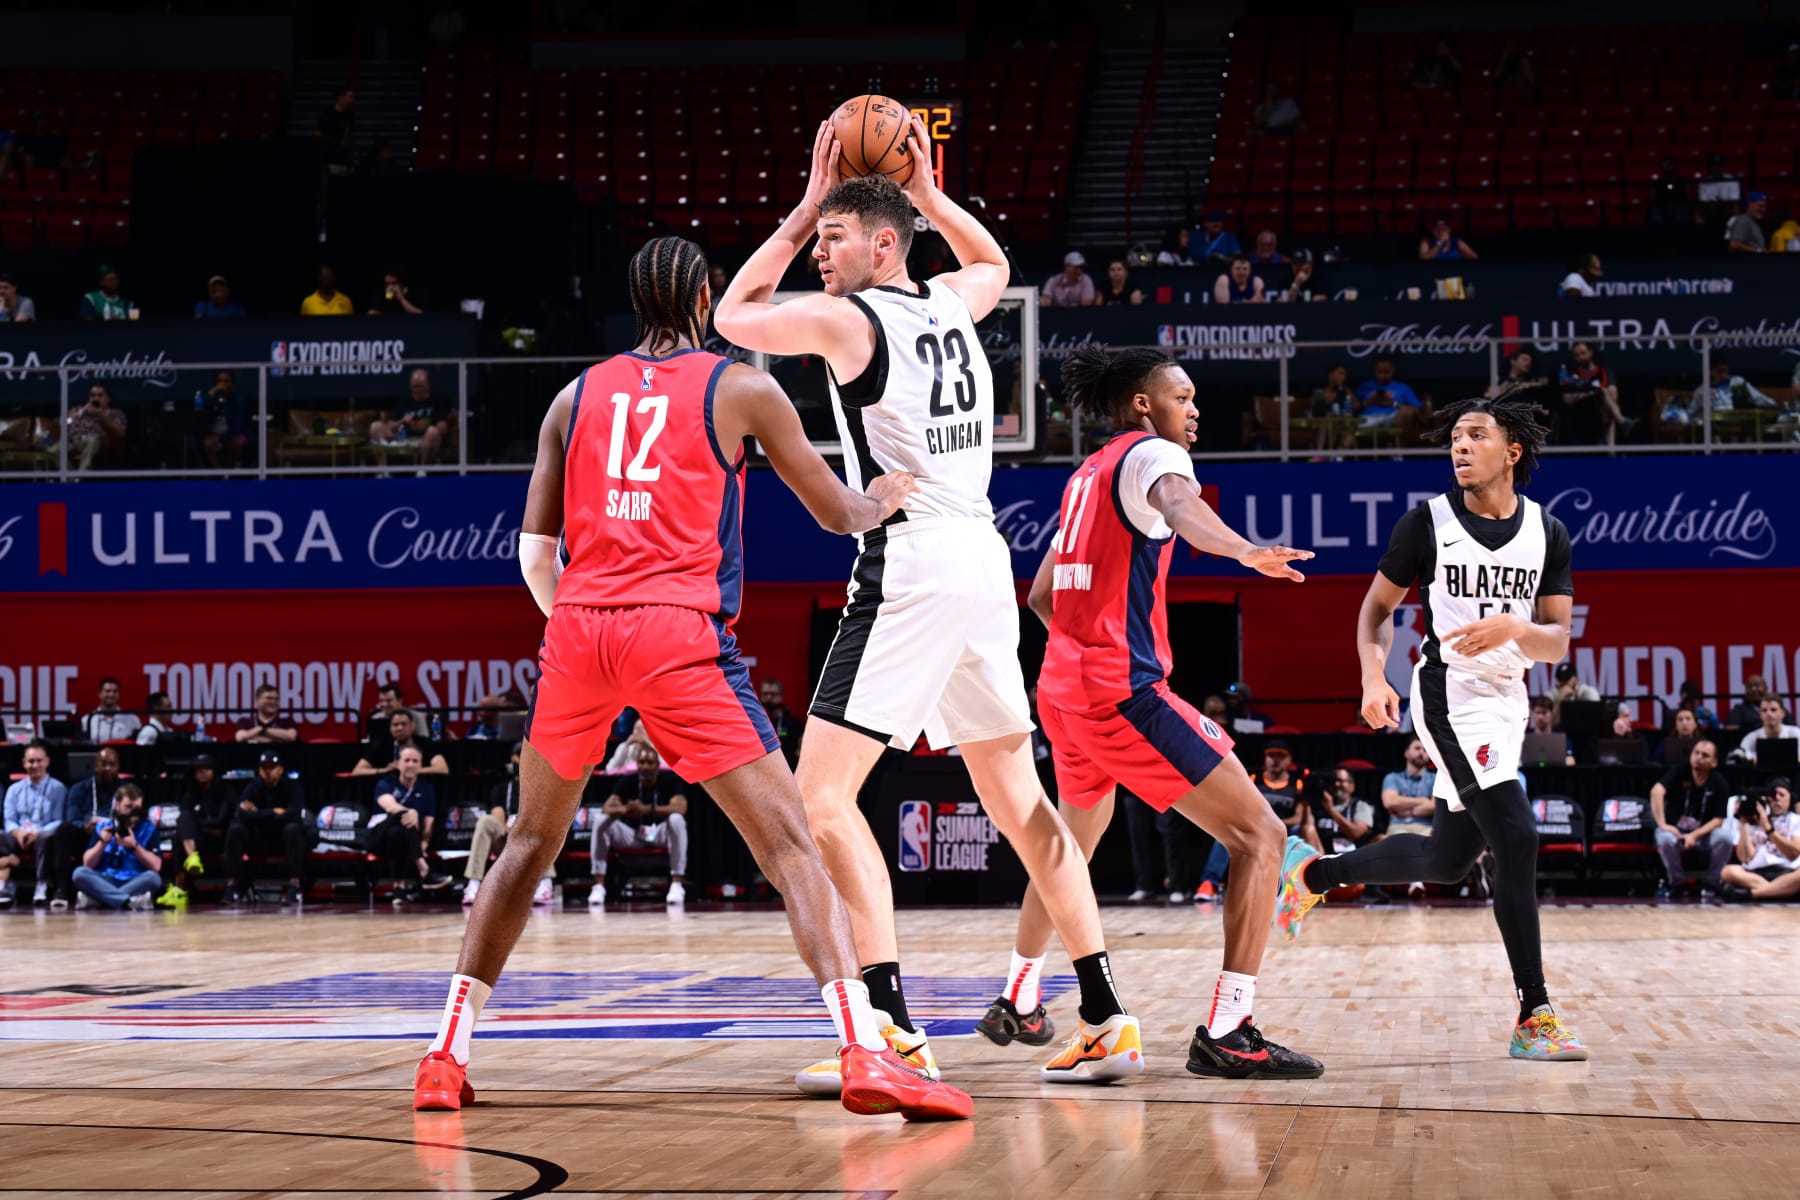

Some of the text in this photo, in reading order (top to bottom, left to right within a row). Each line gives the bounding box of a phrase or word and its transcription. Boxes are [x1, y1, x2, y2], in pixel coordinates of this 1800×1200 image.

[1175, 323, 1297, 360] EXPERIENCES
[1347, 320, 1495, 358] Michelob
[1531, 317, 1677, 353] ULTRA
[58, 348, 177, 388] Courtside
[288, 339, 405, 375] EXPERIENCES
[915, 328, 977, 418] 23
[606, 392, 669, 482] 12
[925, 420, 982, 455] CLINGAN
[605, 488, 652, 521] SARR
[1244, 487, 1777, 560] ULT Courtside
[91, 509, 344, 567] ULTRA
[367, 505, 521, 569] Courts
[1442, 564, 1538, 600] BLAZERS
[1700, 643, 1800, 731] LEA
[935, 815, 999, 843] SUMMER
[935, 843, 989, 871] LEAGUE
